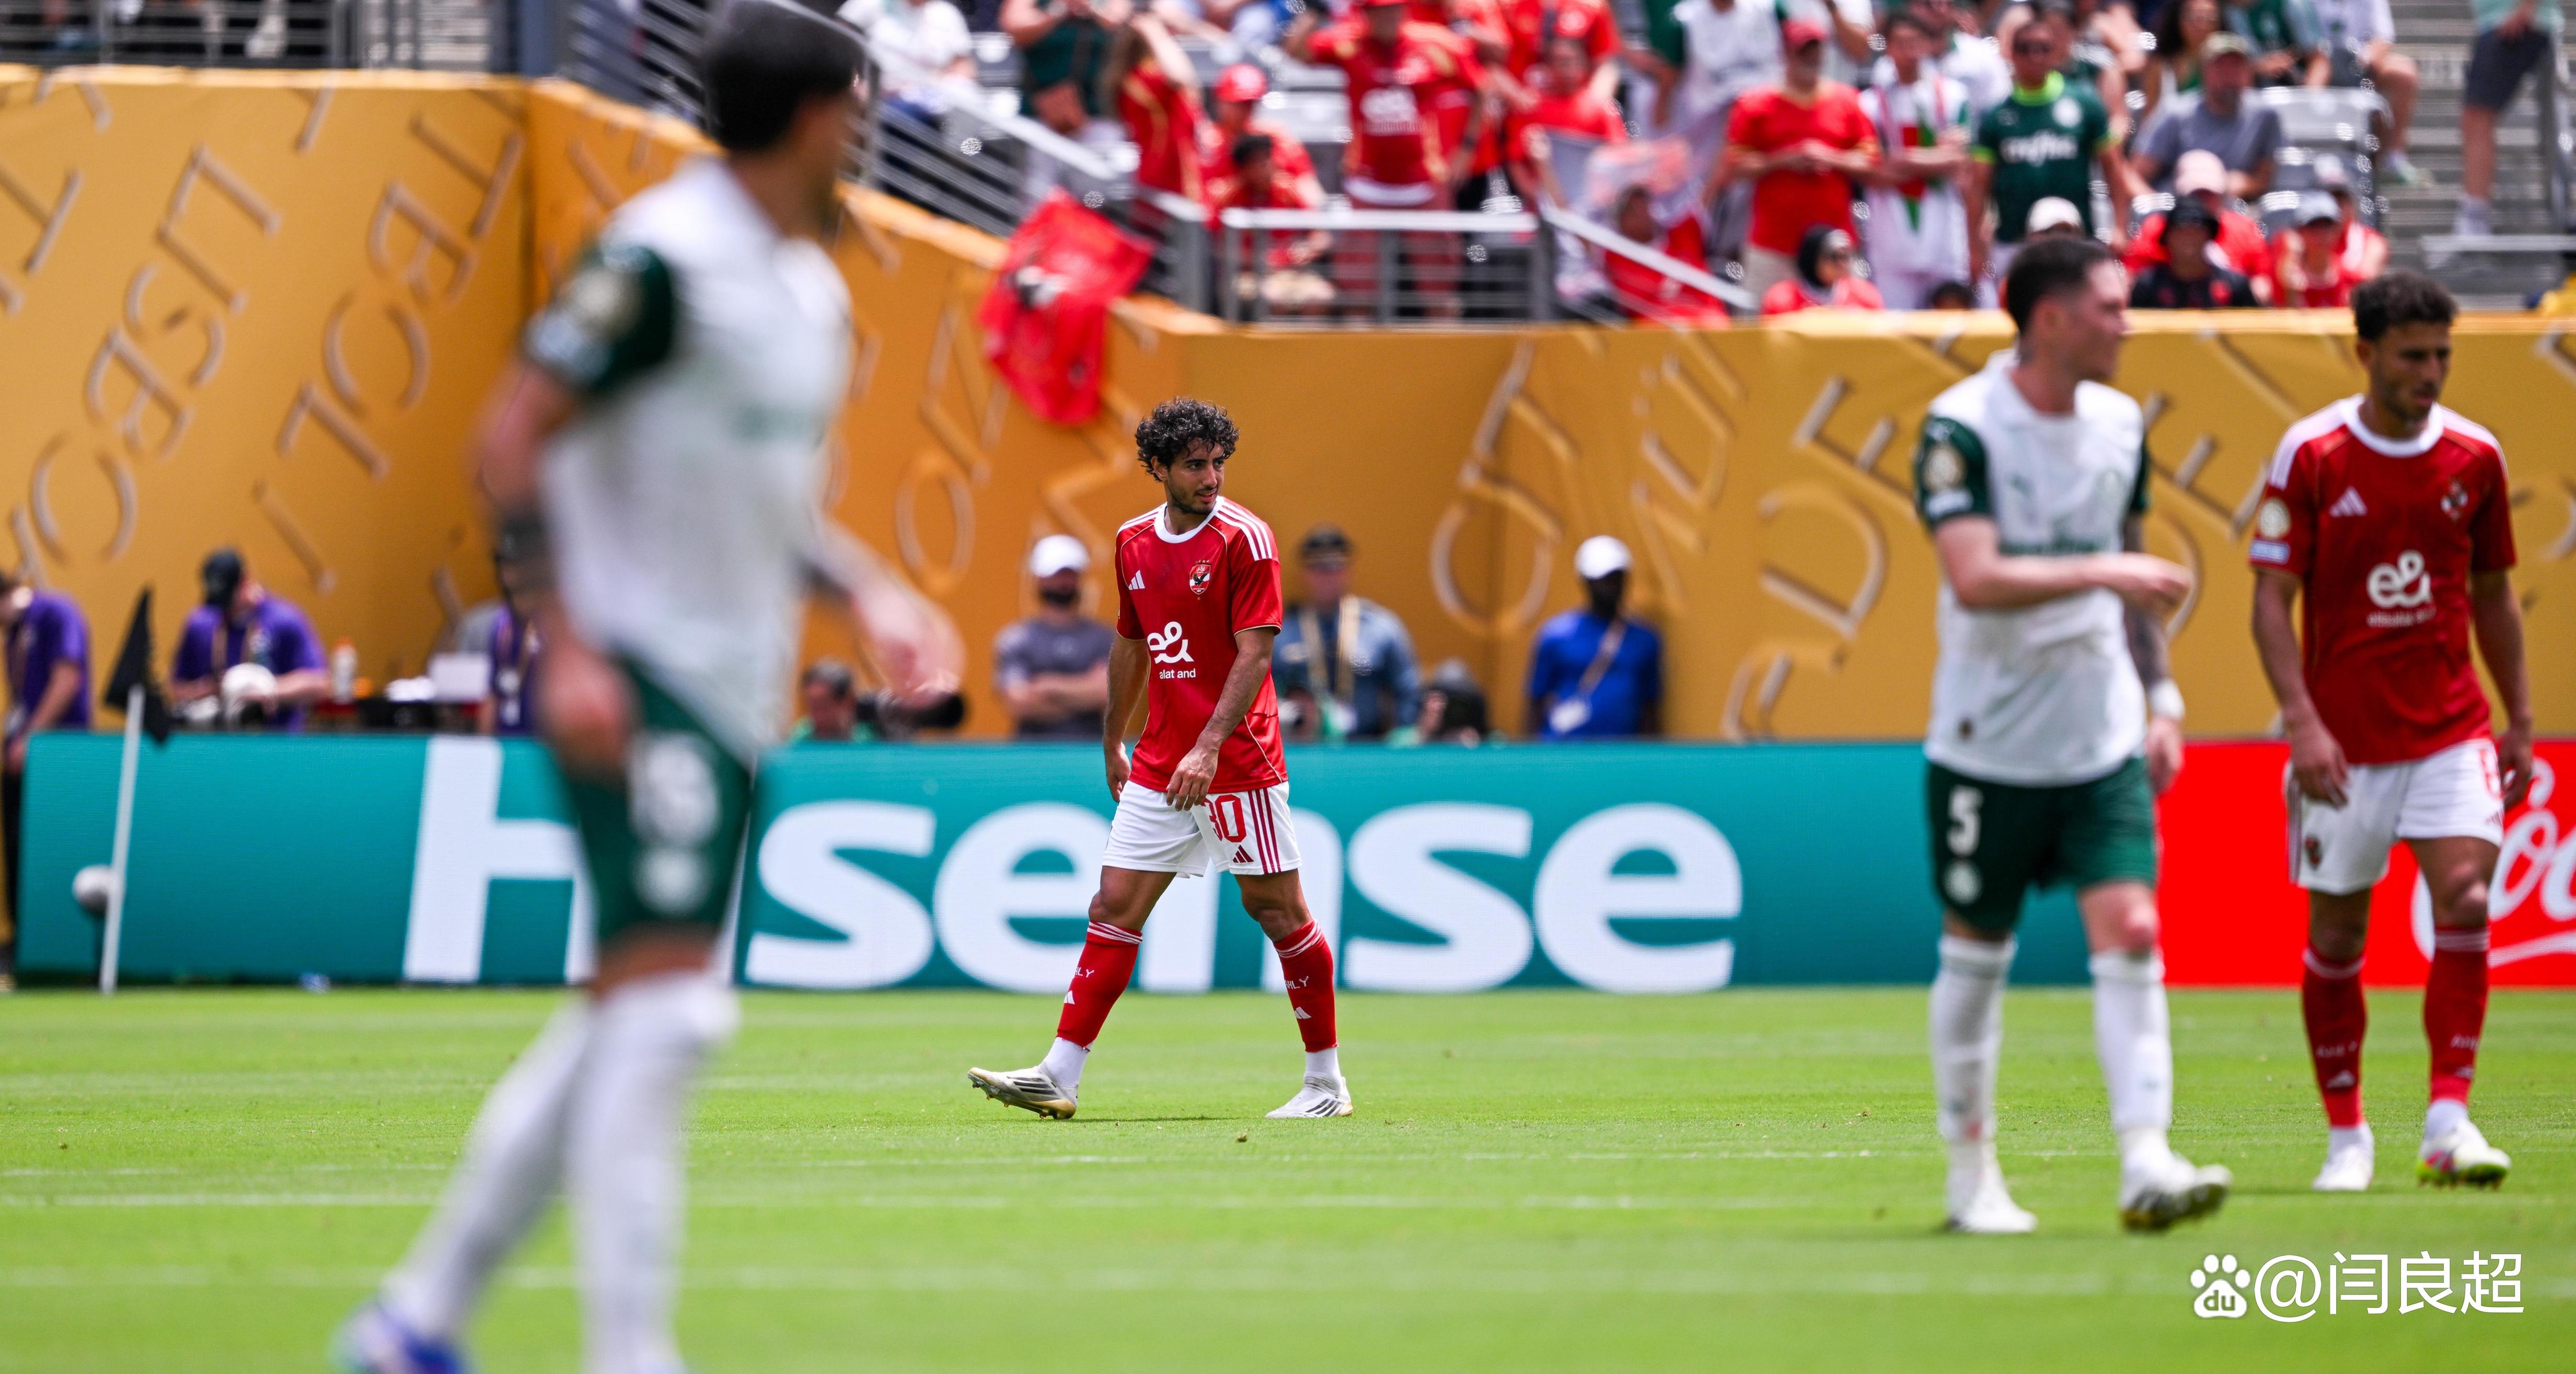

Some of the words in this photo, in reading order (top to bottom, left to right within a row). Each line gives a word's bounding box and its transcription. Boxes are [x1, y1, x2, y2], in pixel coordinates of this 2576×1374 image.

[1177, 668, 1196, 678] and
[1200, 794, 1247, 843] 30
[1946, 784, 1984, 857] 5
[403, 733, 1742, 994] Hsense
